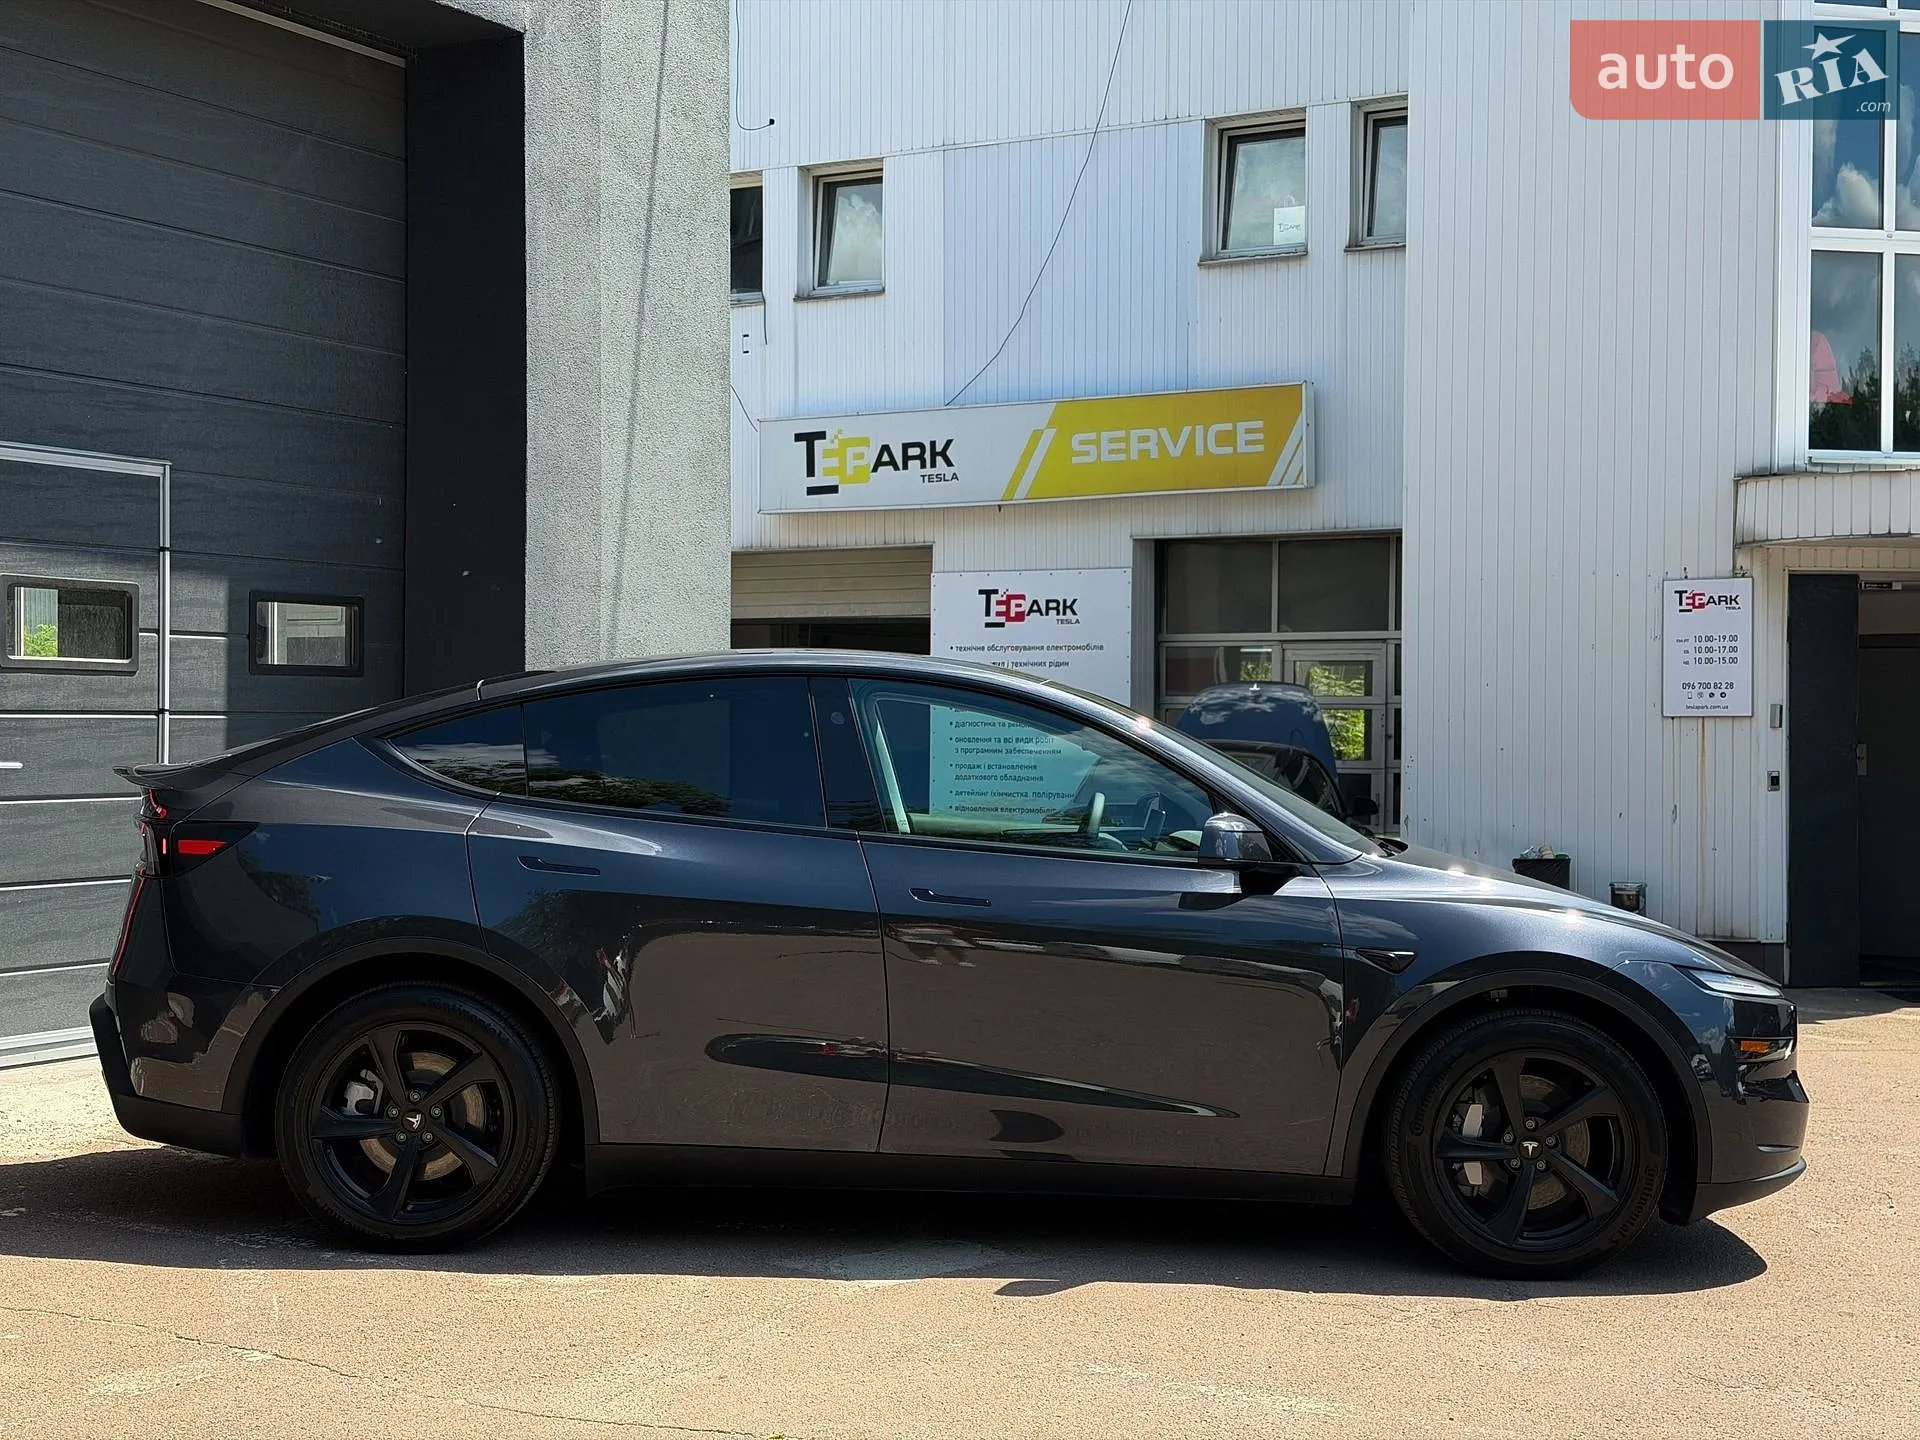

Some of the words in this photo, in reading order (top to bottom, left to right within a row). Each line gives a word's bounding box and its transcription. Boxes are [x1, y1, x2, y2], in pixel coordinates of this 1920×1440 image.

[1071, 420, 1266, 465] SERVICE
[920, 471, 960, 485] TESLA
[1693, 634, 1738, 643] 10.00-19.00
[955, 644, 985, 652] технічне
[986, 643, 1044, 654] обслуговування
[1046, 642, 1104, 653] електромобілів
[1693, 645, 1738, 654] 10.00-17.00
[1011, 660, 1047, 668] технічних
[1048, 660, 1070, 669] рідин
[1693, 656, 1738, 665] 10.00-15.00
[1682, 682, 1696, 690] 096
[1697, 682, 1711, 690] 700
[1713, 682, 1723, 690] 82
[1724, 682, 1734, 690] 28
[954, 721, 996, 729] діагностика
[1003, 736, 1014, 744] всі
[1015, 737, 1034, 745] види
[960, 748, 1003, 756] програмним
[987, 763, 1037, 771] встановлення
[954, 774, 998, 782] додаткового
[999, 774, 1044, 782] обладнання
[954, 805, 999, 813] відновлення
